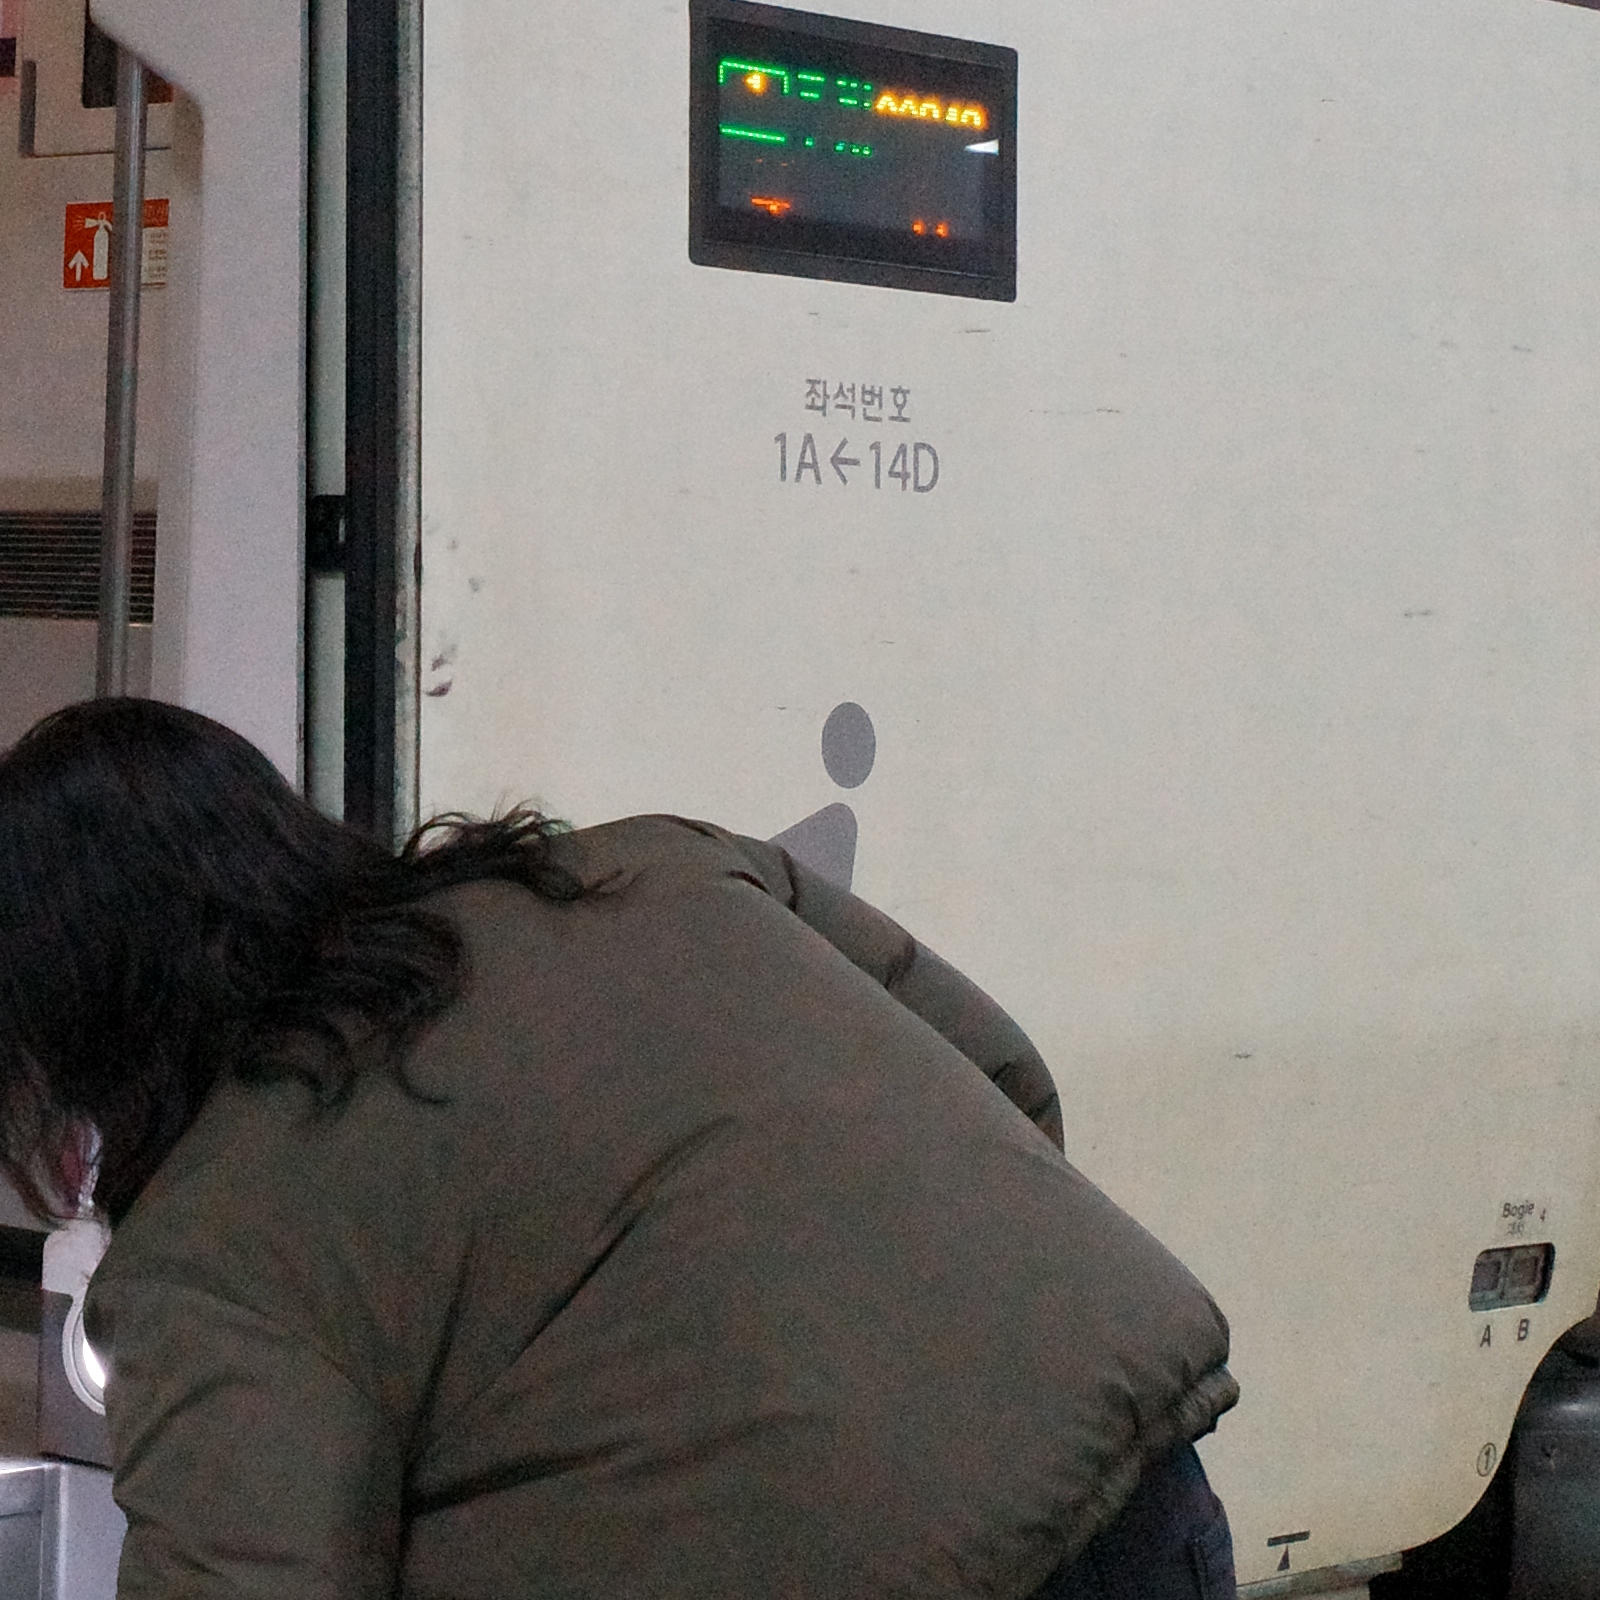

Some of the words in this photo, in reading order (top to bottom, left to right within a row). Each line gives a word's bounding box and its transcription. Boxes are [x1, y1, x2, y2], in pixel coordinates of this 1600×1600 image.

[804, 378, 911, 422] 좌석번호
[1502, 1200, 1535, 1219] Bogie
[1480, 1324, 1492, 1347] A
[1517, 1318, 1529, 1342] B
